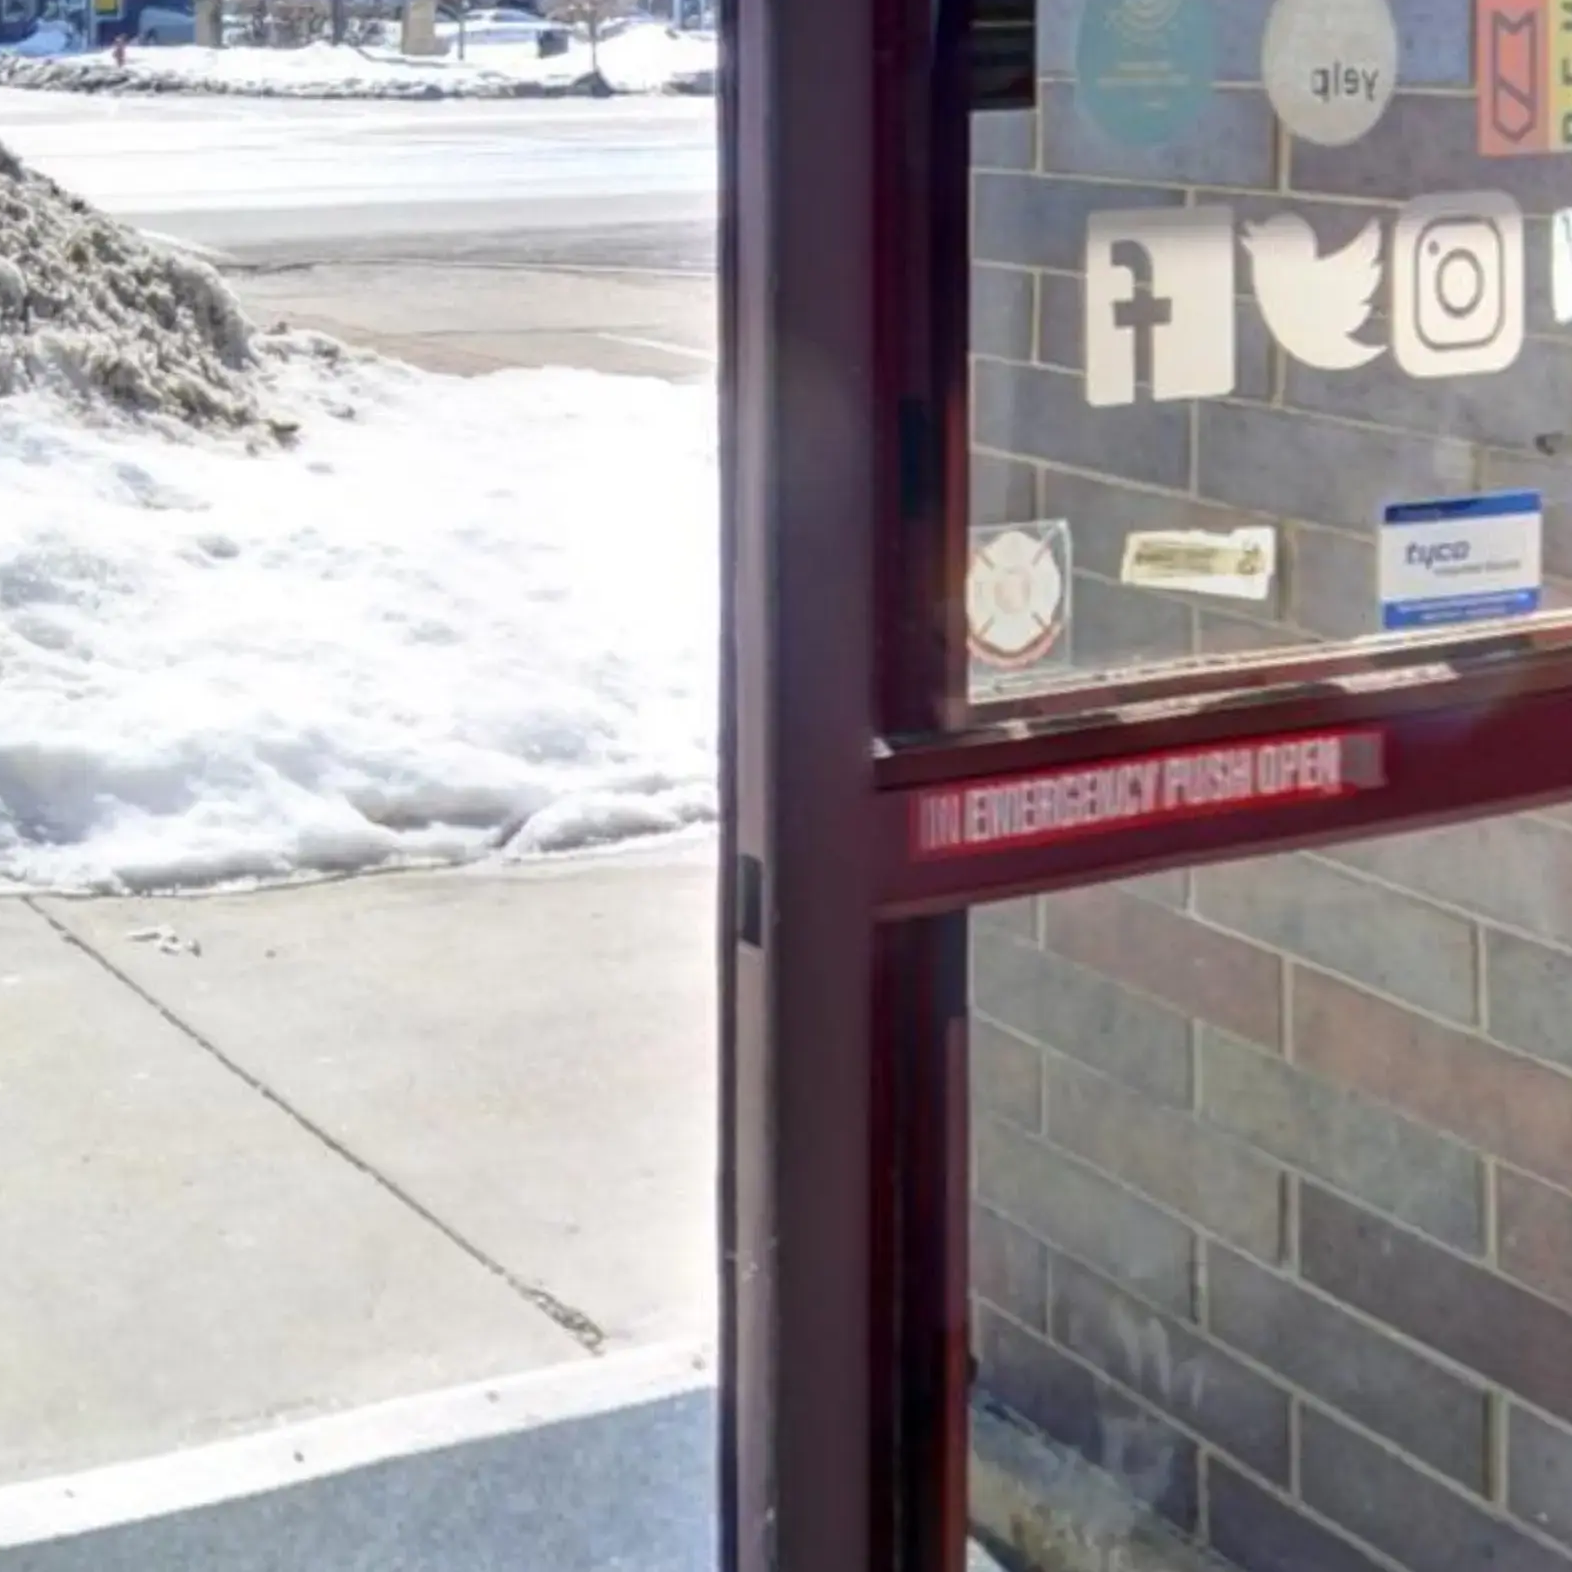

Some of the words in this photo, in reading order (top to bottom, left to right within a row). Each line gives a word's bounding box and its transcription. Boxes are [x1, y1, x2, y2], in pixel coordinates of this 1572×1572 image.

[1405, 540, 1471, 570] tyco
[963, 762, 1158, 844] EMERGENCY
[1162, 747, 1253, 810] PUSH
[1256, 736, 1343, 796] OPEN
